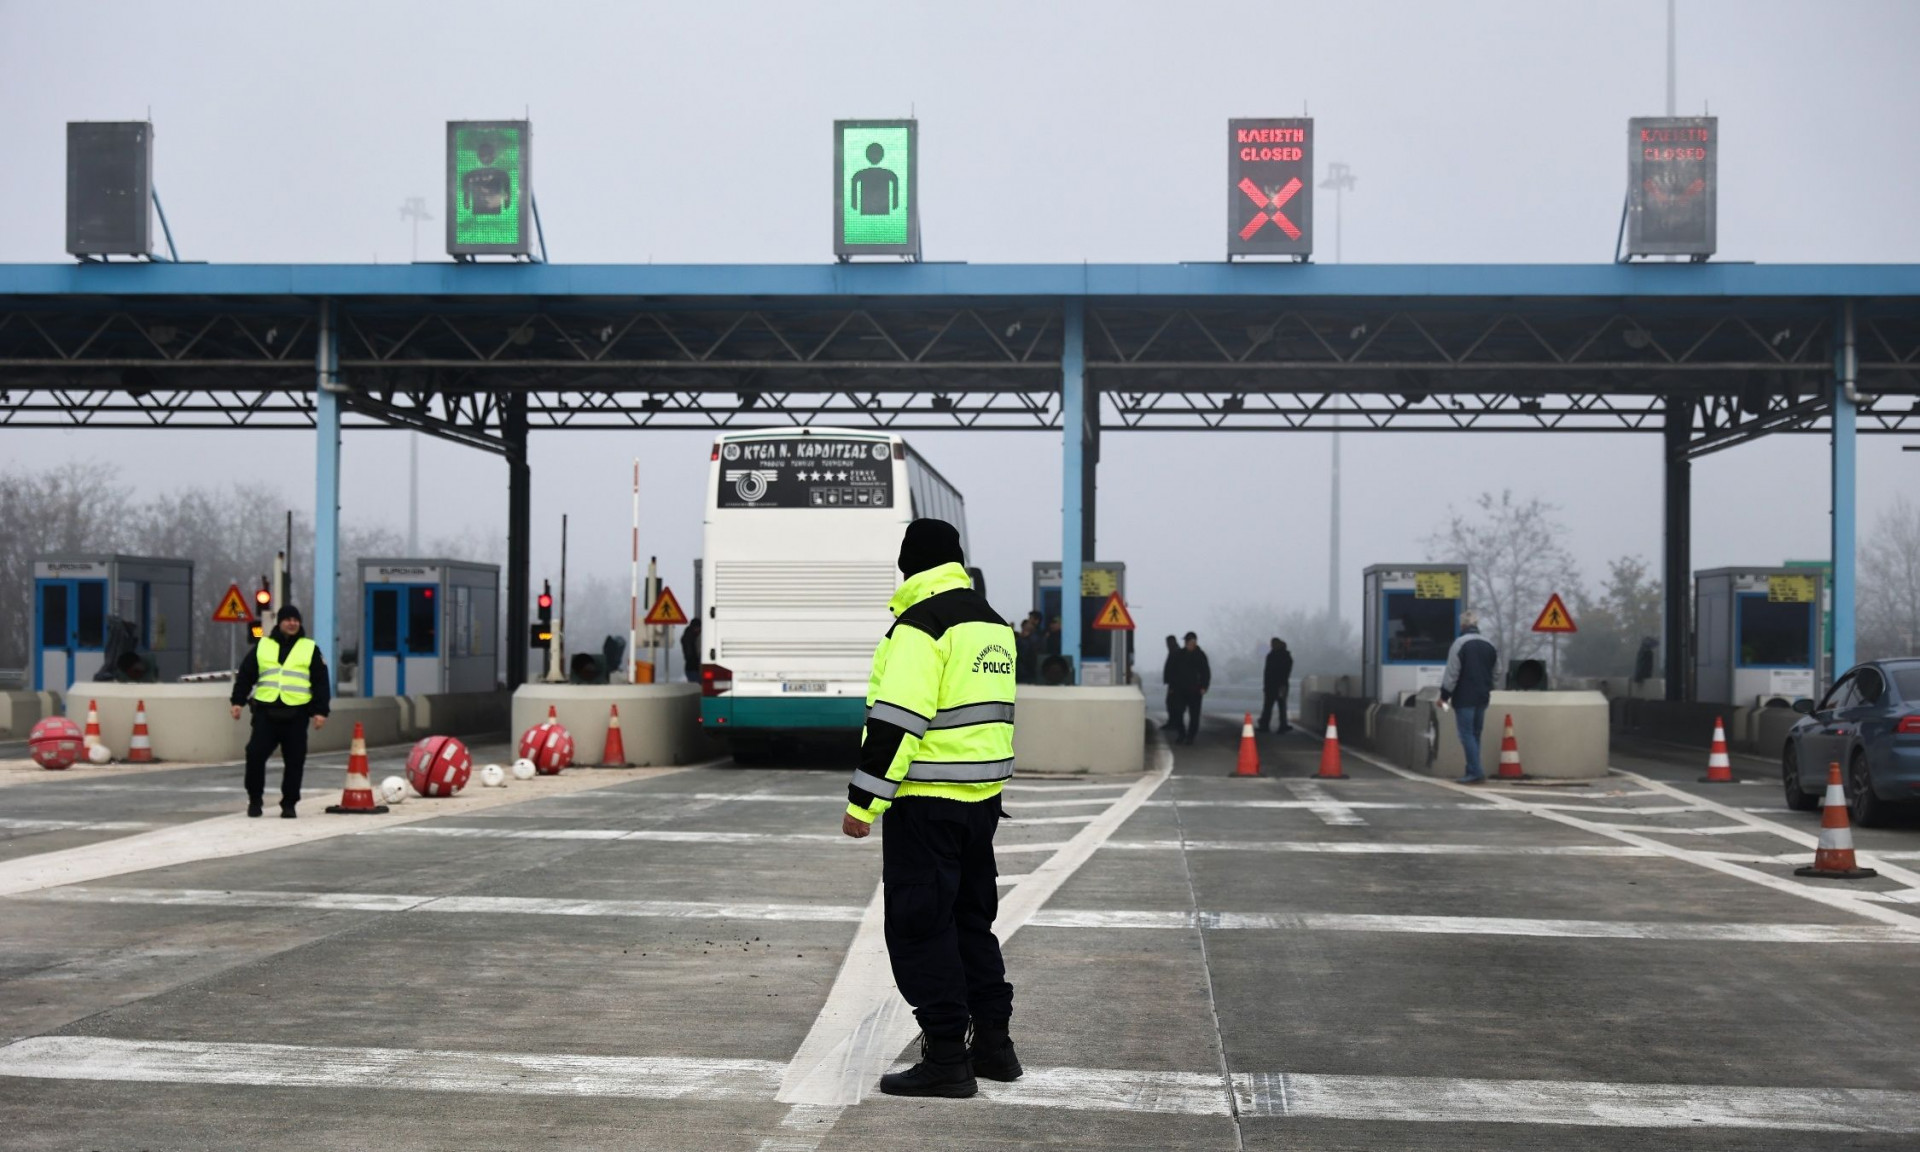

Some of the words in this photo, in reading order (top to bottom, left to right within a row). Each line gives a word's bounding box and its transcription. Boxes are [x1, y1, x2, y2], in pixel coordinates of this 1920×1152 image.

[1237, 128, 1304, 143] ΚΛΕΙΣΤΗ
[1240, 147, 1303, 161] CLOSED
[1644, 148, 1706, 161] CLOSED
[744, 444, 775, 460] ΚΤΕΛ
[797, 443, 868, 459] ΚΑΡΔΙΤΣΑΣ
[983, 661, 1011, 674] POLICE
